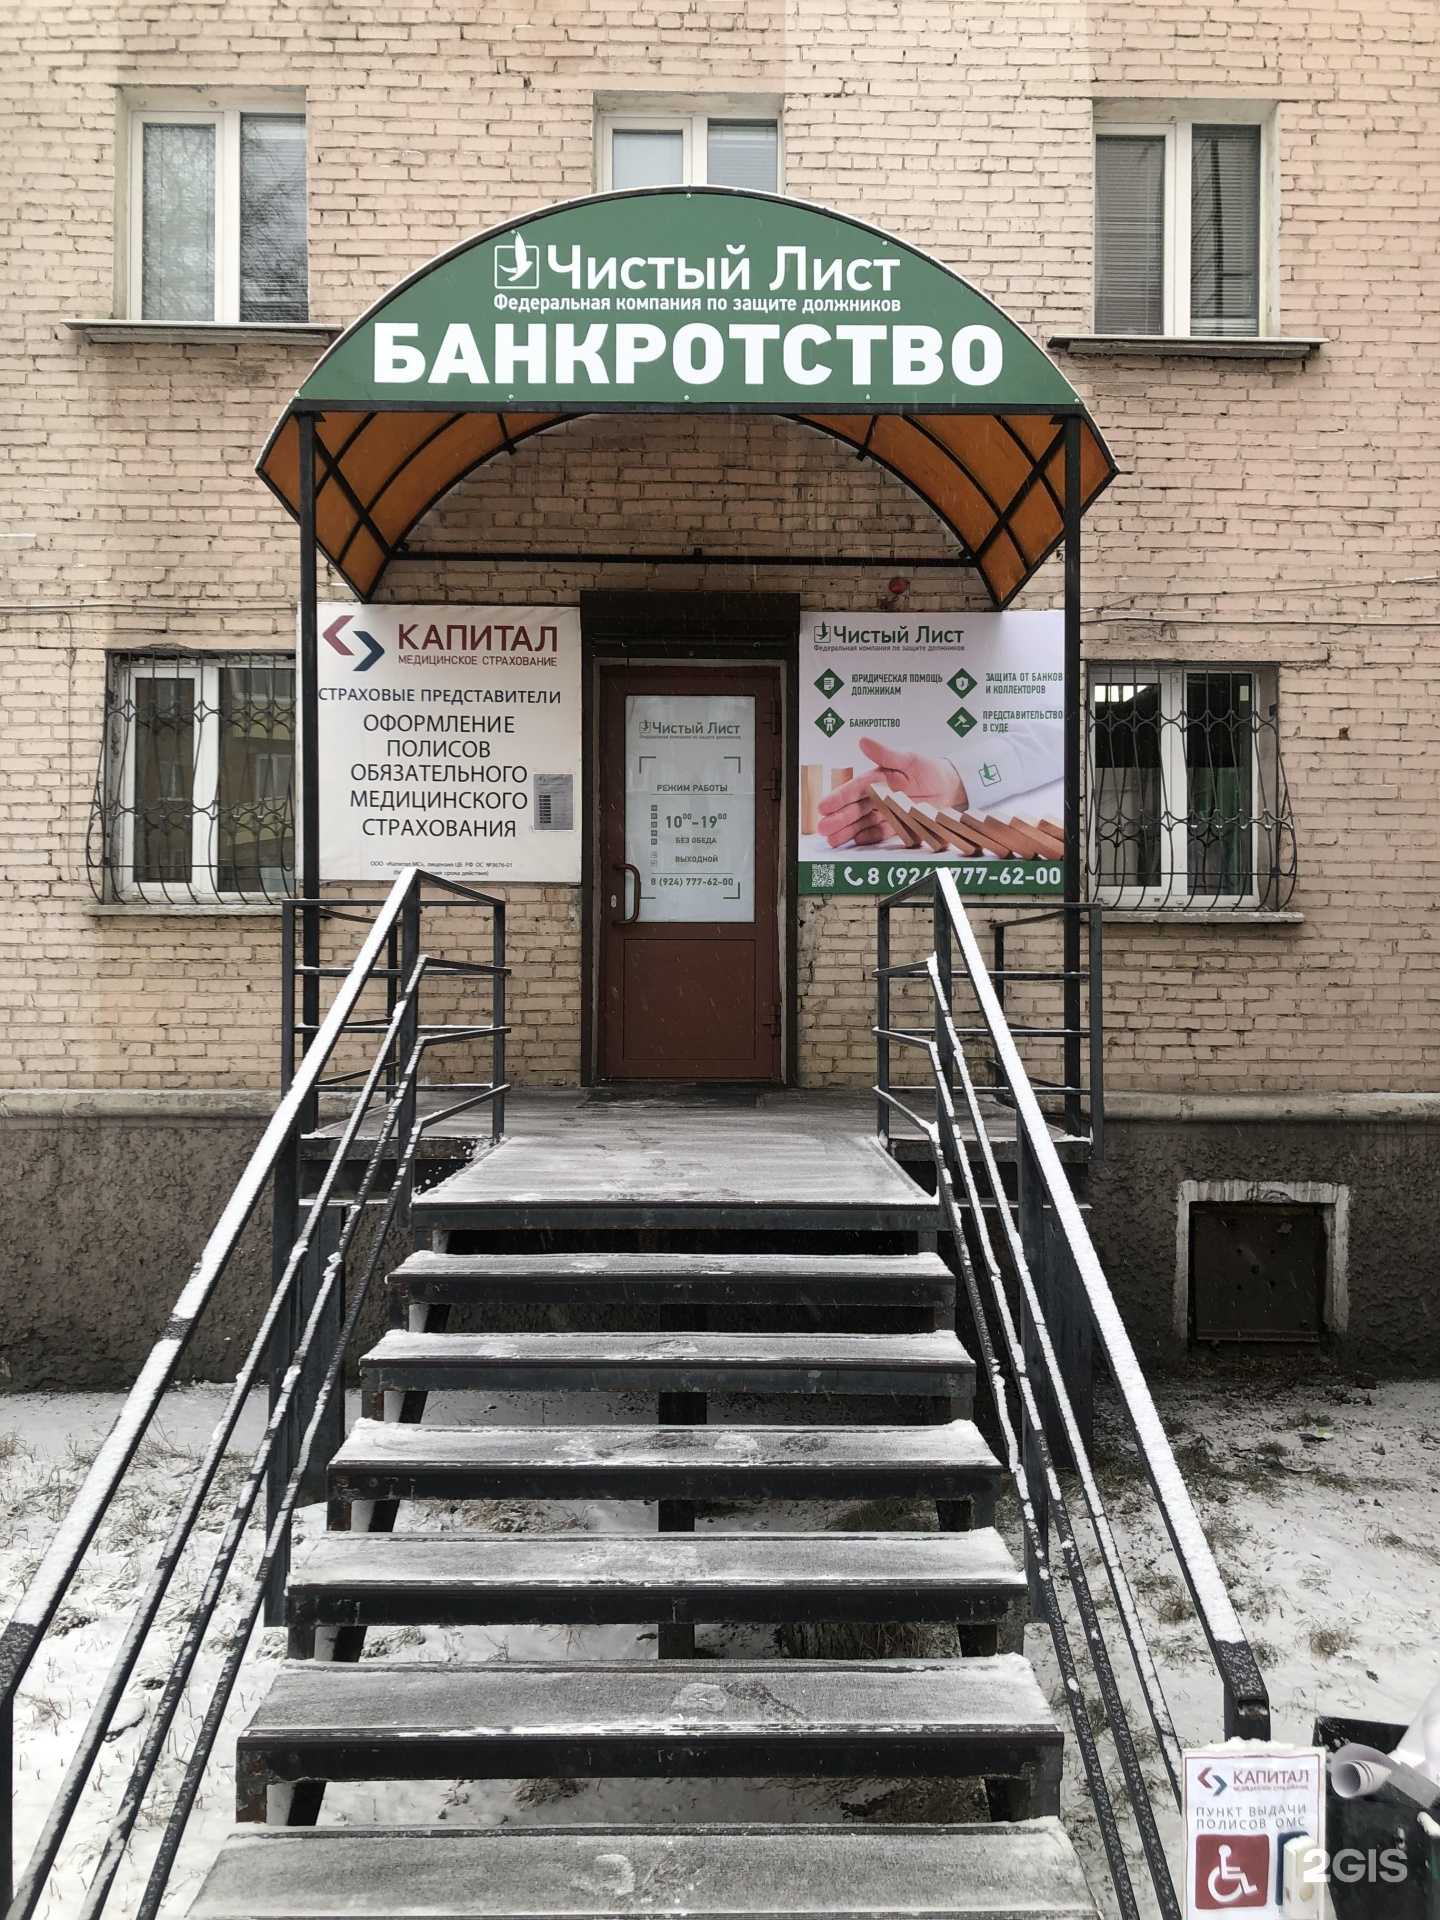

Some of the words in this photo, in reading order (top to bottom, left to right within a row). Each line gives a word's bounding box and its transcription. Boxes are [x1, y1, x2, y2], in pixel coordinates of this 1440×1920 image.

[548, 243, 750, 290] Чистый
[769, 245, 901, 291] Лист
[493, 293, 611, 314] Федеральная
[616, 297, 701, 311] компания
[707, 297, 727, 311] по
[733, 298, 797, 314] защите
[802, 299, 901, 314] должников
[373, 321, 1003, 386] БАНКРОТСТВО
[398, 624, 558, 653] КАПИТАЛ
[834, 625, 909, 643] Чистый
[915, 625, 965, 643] Лист
[398, 655, 478, 666] МЕДИЦИНСКОЕ
[482, 656, 558, 667] СТРАХОВАНИЕ
[851, 673, 907, 684] ЮРИДИЧЕСКАЯ
[910, 674, 943, 684] ПОМОЩЬ
[986, 672, 1017, 683] ЗАЩИТА
[1020, 672, 1029, 682] ОТ
[1032, 672, 1063, 682] БАНКОВ
[318, 687, 415, 702] СТРАХОВЫЕ
[421, 689, 561, 705] ПРЕДСТАВИТЕЛИ
[851, 686, 901, 696] ДОЛЖНИКАМ
[986, 685, 991, 694] И
[993, 684, 1046, 694] КОЛЛЕКТОРОВ
[983, 710, 1063, 721] ПРЕДСТАВИТЕЛЬСТВО
[363, 714, 515, 733] ОФОРМЛЕНИЕ
[653, 721, 703, 734] Чистый
[708, 722, 740, 734] Лист
[850, 718, 900, 728] БАНКРОТСТВО
[983, 724, 987, 732] В
[989, 723, 1009, 733] СУДЕ
[387, 739, 491, 758] ПОЛИСОВ
[350, 763, 528, 783] ОБЯЗАТЕЛЬНОГО
[657, 784, 690, 792] РЕЖИМ
[692, 784, 728, 792] РАБОТЫ
[350, 790, 528, 811] МЕДИЦИНСКОГО
[362, 819, 516, 838] СТРАХОВАНИЯ
[675, 855, 718, 864] ВЫХОДНОЙ
[659, 877, 683, 887] (924)
[686, 877, 733, 886] 777-62-00
[867, 867, 880, 885] 8
[1233, 1769, 1309, 1784] КАПИТАЛ
[1196, 1806, 1242, 1817] ПУНКТ
[1249, 1804, 1306, 1817] ВЫДАЧИ
[1197, 1819, 1266, 1830] ПОЛИСОВ
[1276, 1816, 1305, 1828] ОМС
